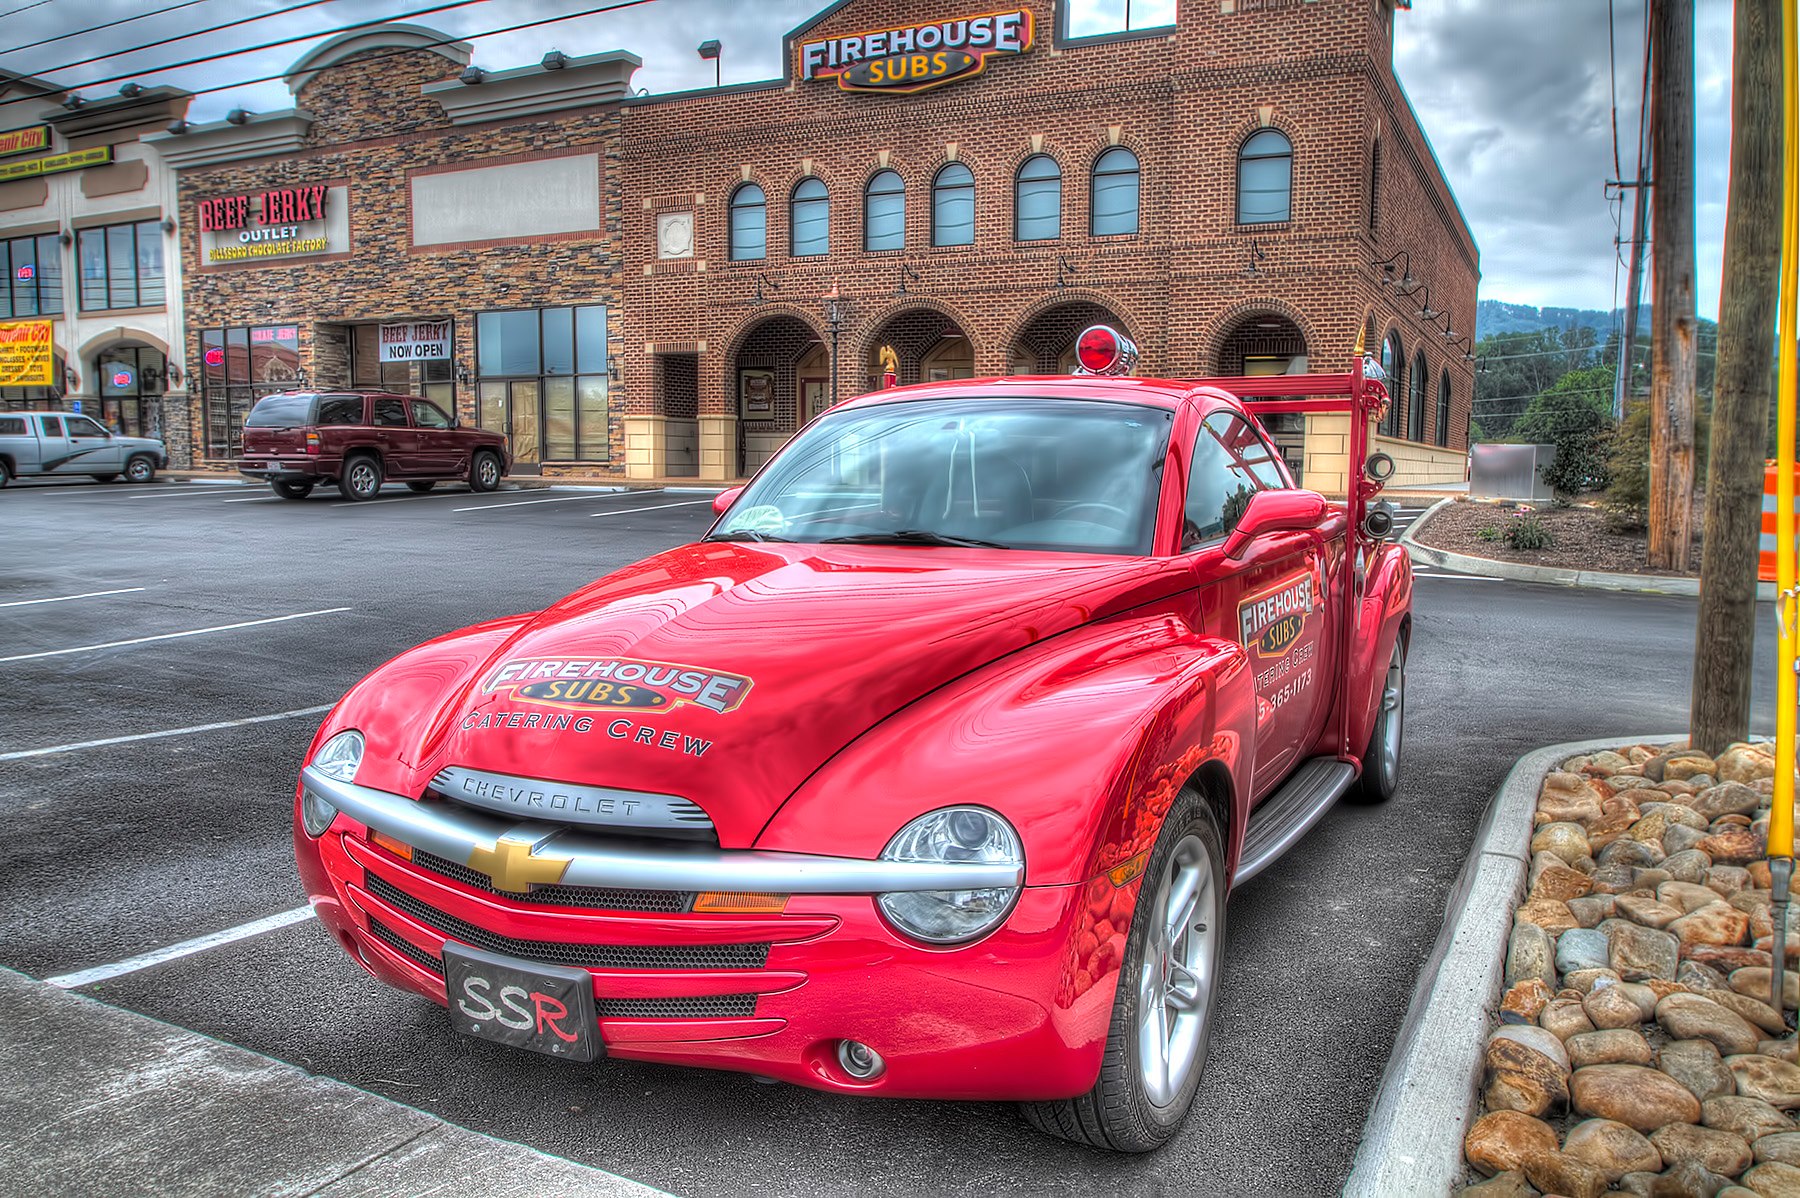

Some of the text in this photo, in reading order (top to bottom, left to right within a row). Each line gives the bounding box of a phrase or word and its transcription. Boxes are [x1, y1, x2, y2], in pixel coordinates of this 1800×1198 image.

[802, 11, 1023, 81] FIREHOUSE
[869, 52, 947, 83] SUBS
[21, 131, 43, 147] City
[201, 185, 326, 232] BEEF JERKY
[239, 225, 298, 243] OUTLET
[248, 240, 292, 257] CHOCOLATE
[292, 237, 328, 253] FACTORY
[382, 322, 449, 343] BEEF JERKY
[389, 343, 443, 359] NOW OPEN
[1242, 579, 1312, 650] FIREHOUSE
[1270, 616, 1295, 649] SUBS
[484, 660, 745, 713] FIREHOUSE
[544, 681, 637, 706] SUBS
[462, 711, 713, 757] CATERING CREW
[463, 777, 641, 816] CHEVROLET
[458, 976, 578, 1043] SSR
